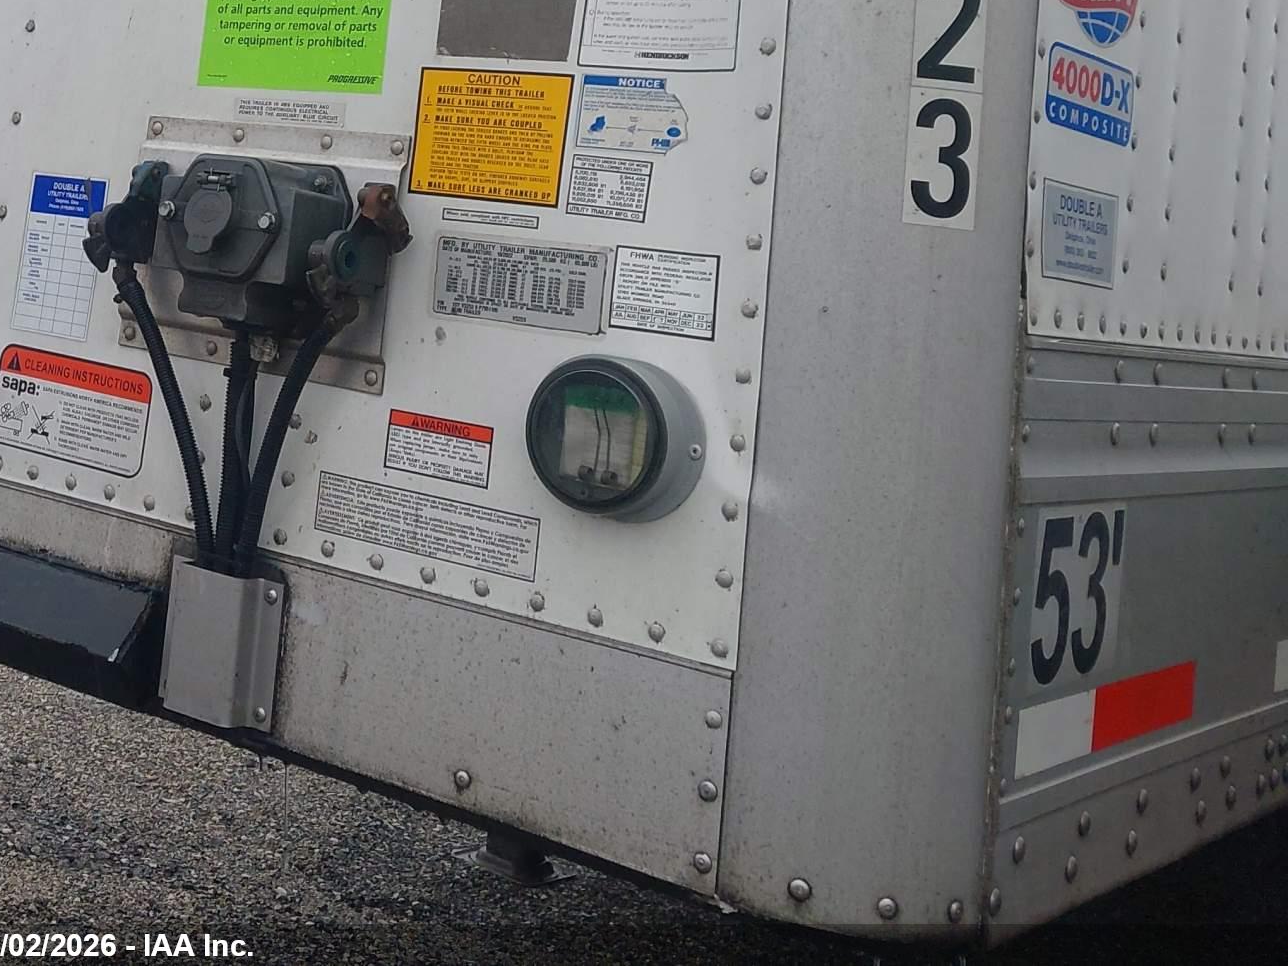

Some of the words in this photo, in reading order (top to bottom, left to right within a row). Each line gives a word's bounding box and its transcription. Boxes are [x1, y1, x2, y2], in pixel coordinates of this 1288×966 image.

[218, 4, 229, 15] of
[231, 4, 243, 14] all
[246, 5, 271, 17] parts
[275, 4, 293, 15] and
[297, 5, 358, 17] equipment.
[362, 5, 383, 18] Any
[220, 21, 271, 33] tampering
[288, 21, 331, 31] removal
[334, 21, 346, 31] of
[349, 22, 377, 34] parts
[224, 37, 234, 45] or
[238, 36, 293, 47] equipment
[296, 36, 304, 46] is
[307, 35, 367, 49] prohibited.
[327, 75, 378, 84] PROGRESSIVE
[468, 74, 521, 86] CAUTION
[618, 78, 661, 88] NOTICE
[1053, 56, 1130, 115] 4000D-X
[438, 85, 463, 93] BEFORE
[466, 87, 492, 95] TOWING
[515, 90, 545, 98] TRAILER
[437, 97, 455, 105] MAKE
[465, 99, 489, 107] VISUAL
[491, 101, 514, 109] CHECK
[435, 115, 453, 123] MAKE
[457, 116, 473, 124] SURE
[510, 120, 542, 129] COUPLED
[1049, 100, 1128, 142] COMPOSITE
[48, 190, 66, 198] UTILITY
[53, 182, 79, 192] DOUBLE
[427, 181, 445, 189] MAKE
[448, 183, 466, 191] SURE
[469, 185, 485, 193] LEGS
[488, 187, 502, 195] ARE
[505, 188, 538, 198] CRANKED
[541, 192, 551, 200] UP
[1060, 194, 1095, 217] DOUBLE
[1096, 203, 1103, 218] A
[1052, 213, 1076, 229] UTILITY
[1078, 218, 1108, 236] TRAILERS
[473, 243, 496, 251] UTILITY
[500, 246, 525, 254] TRAILER
[529, 249, 584, 261] MANUFACTURING
[630, 252, 654, 260] FHWA
[24, 358, 70, 379] CLEANING
[72, 368, 144, 395] INSTRUCTIONS
[1, 376, 41, 396] sapa:
[54, 389, 78, 399] EXTRUSIONS
[79, 395, 93, 403] NORTH
[93, 398, 112, 407] AMERICA
[112, 402, 143, 414] RECOMMENDS
[421, 418, 471, 437] WARNING
[1031, 509, 1126, 685] 53'
